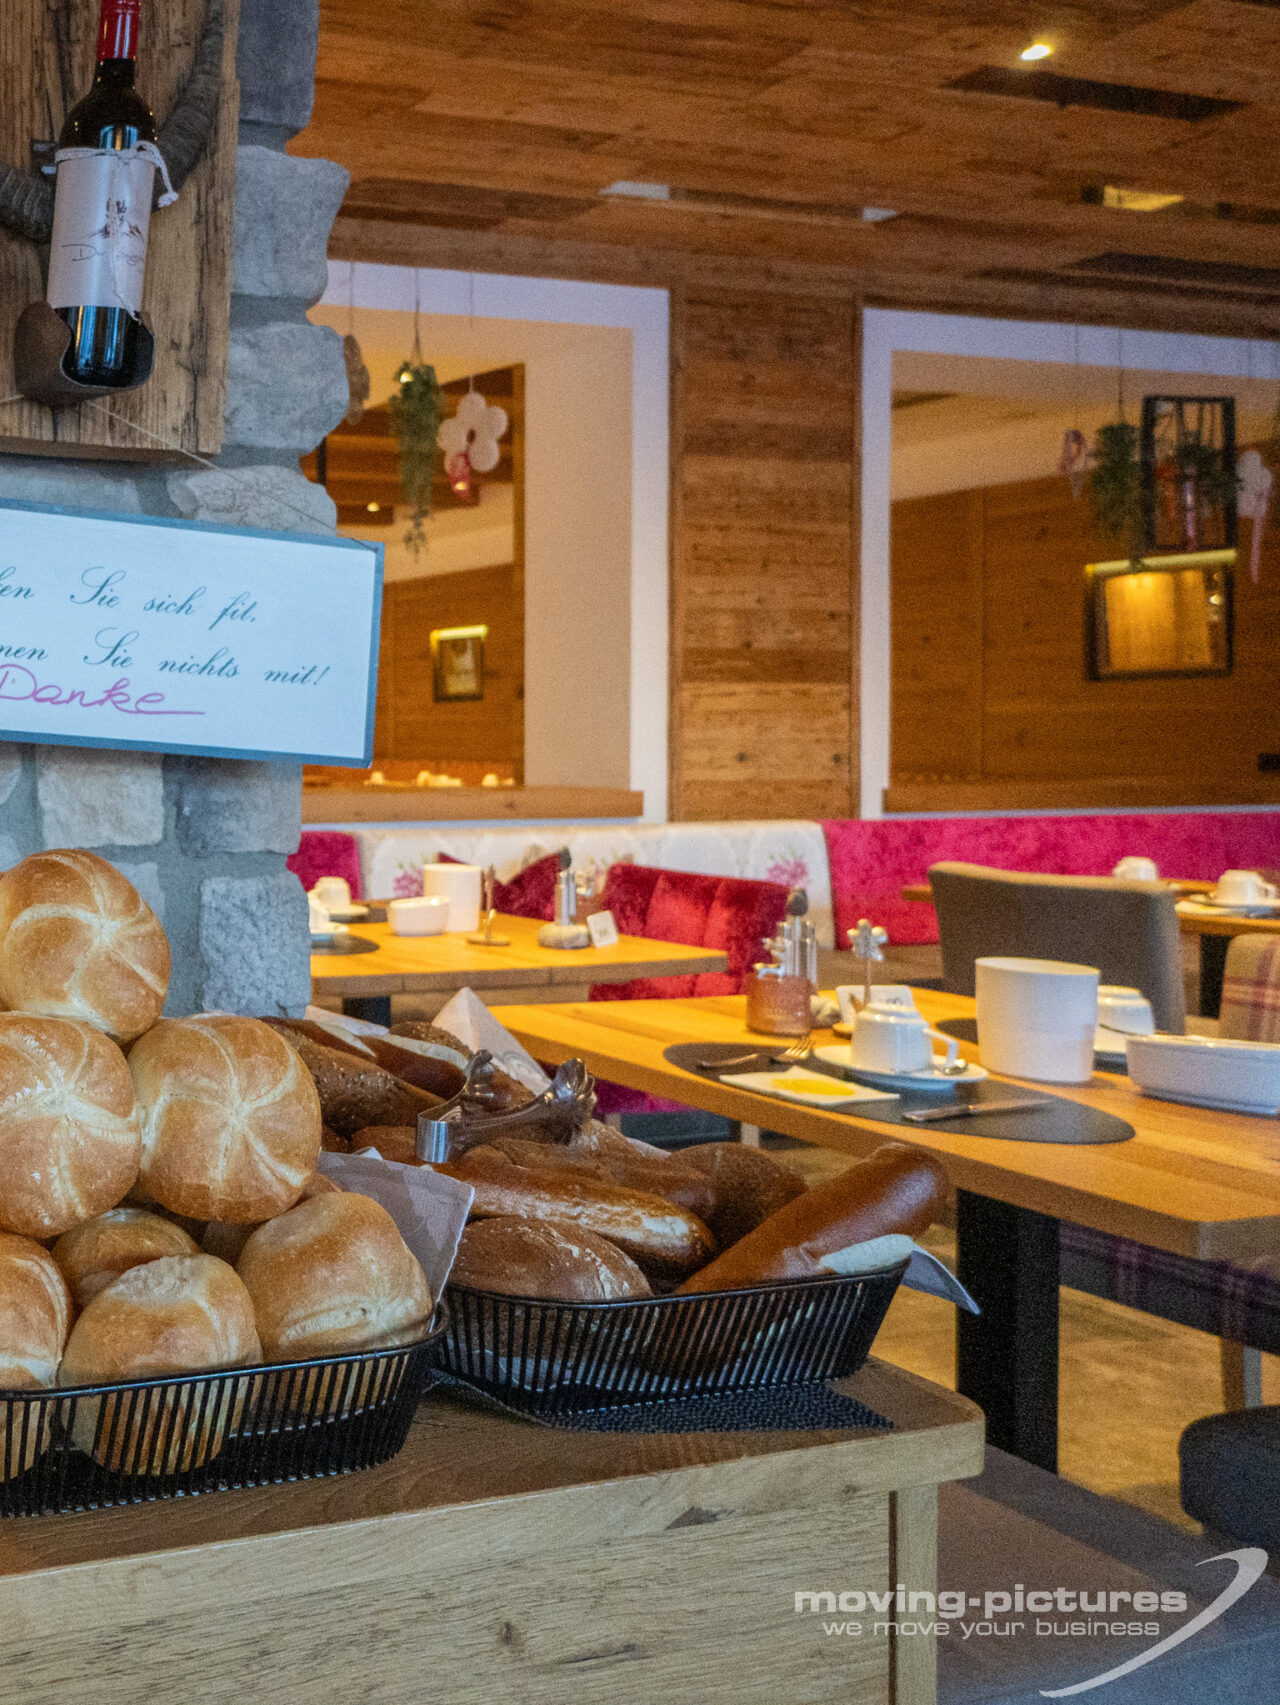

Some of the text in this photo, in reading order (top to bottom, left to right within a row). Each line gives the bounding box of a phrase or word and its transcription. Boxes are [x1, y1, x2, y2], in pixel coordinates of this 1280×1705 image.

[69, 566, 127, 610] Sie
[143, 586, 208, 617] sich
[83, 627, 140, 670] Sie
[158, 647, 240, 679] nichts
[263, 665, 331, 687] mit!
